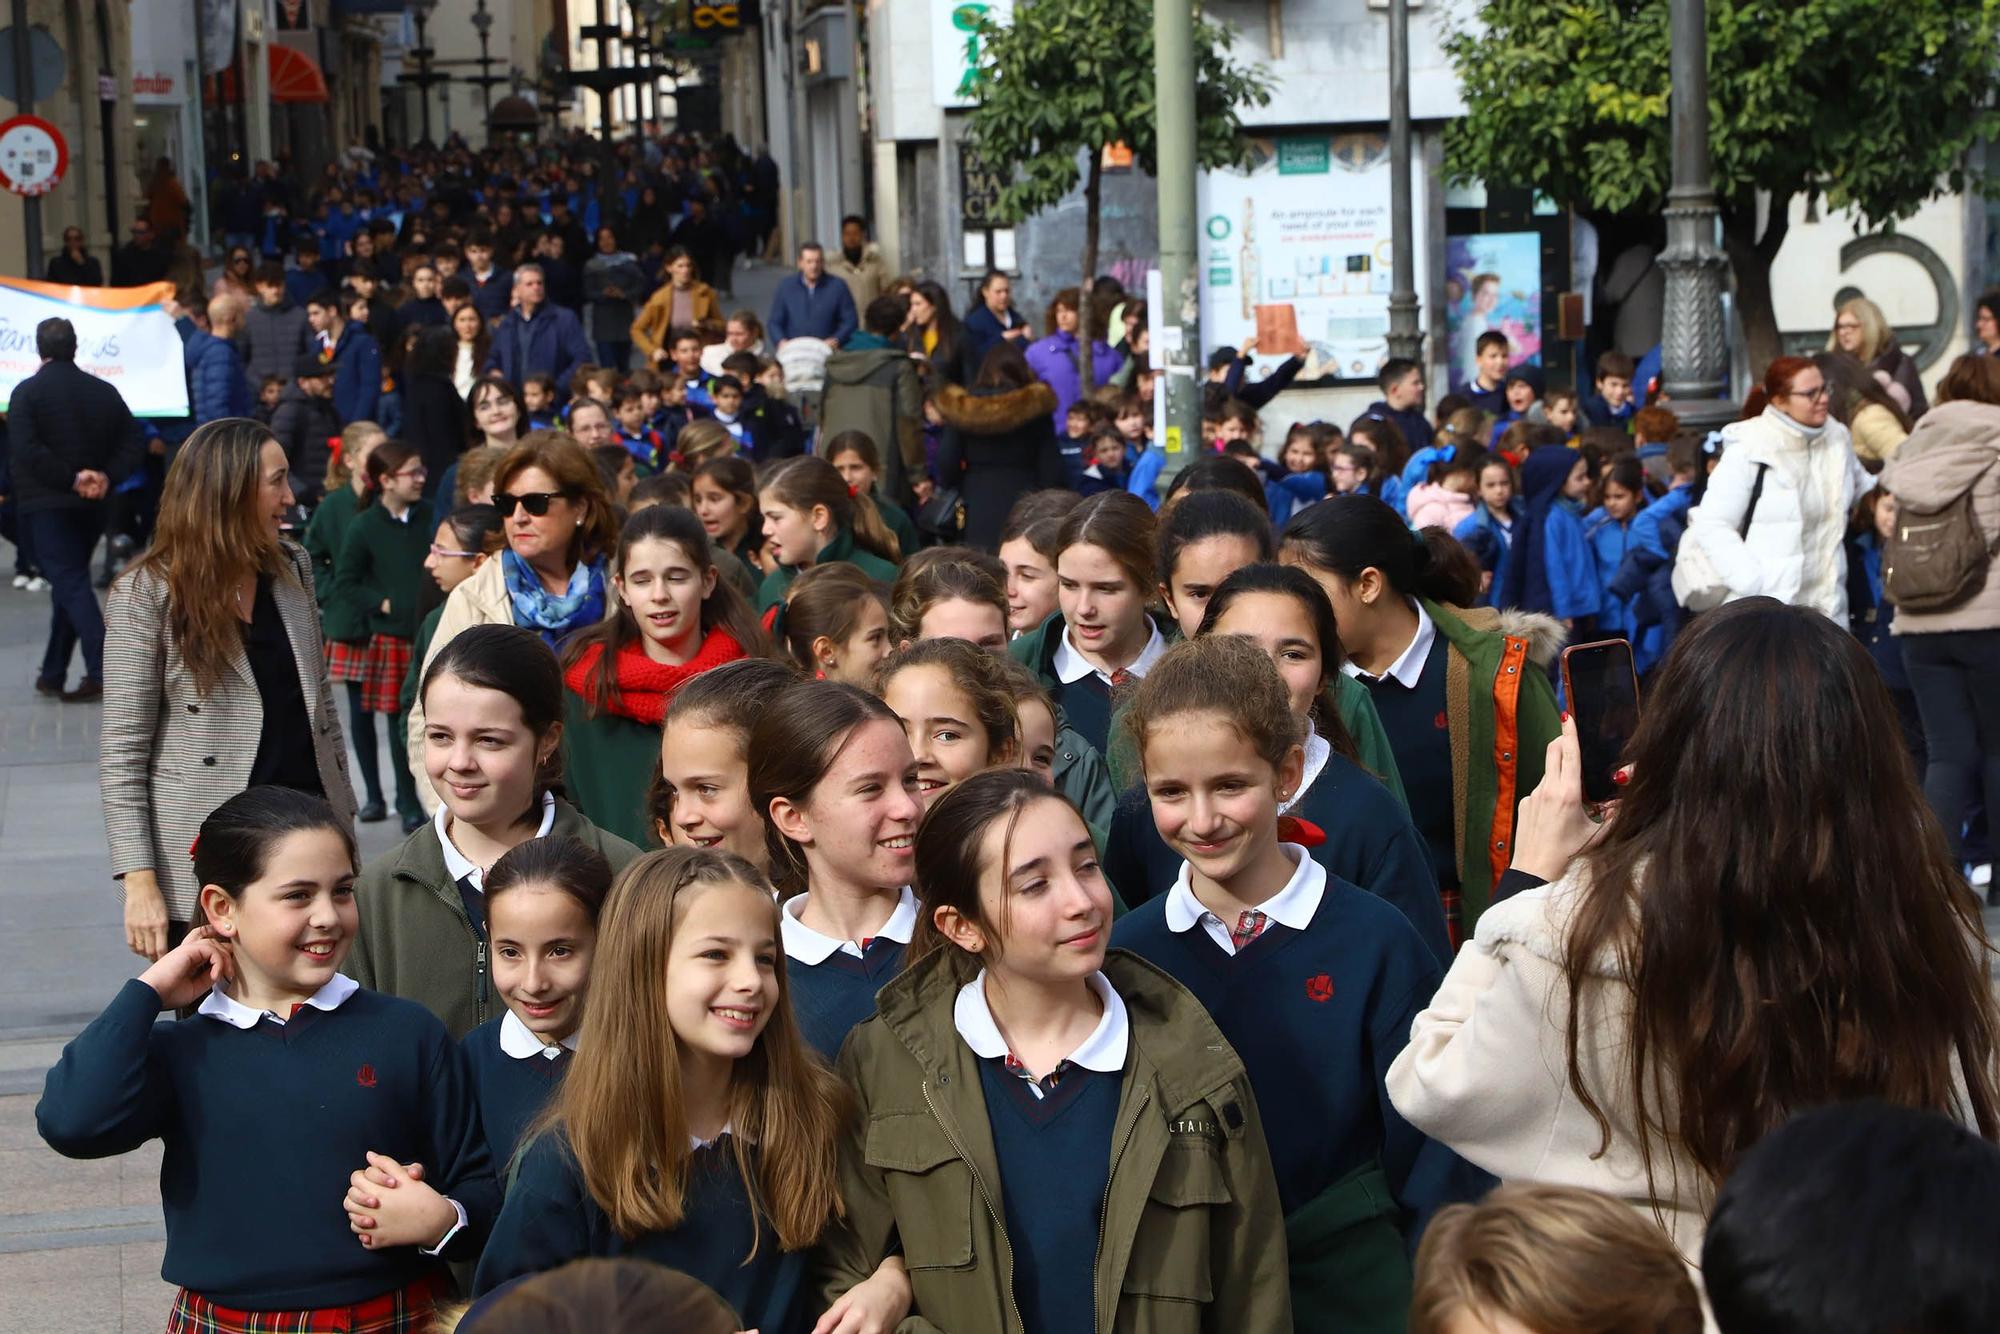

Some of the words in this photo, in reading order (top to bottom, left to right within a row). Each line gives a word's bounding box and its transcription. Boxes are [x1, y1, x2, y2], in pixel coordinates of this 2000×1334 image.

[1288, 208, 1337, 221] ampoule
[1341, 207, 1355, 216] for
[1360, 206, 1385, 215] each
[1280, 222, 1309, 231] need
[1312, 220, 1323, 229] of
[1326, 221, 1348, 232] your
